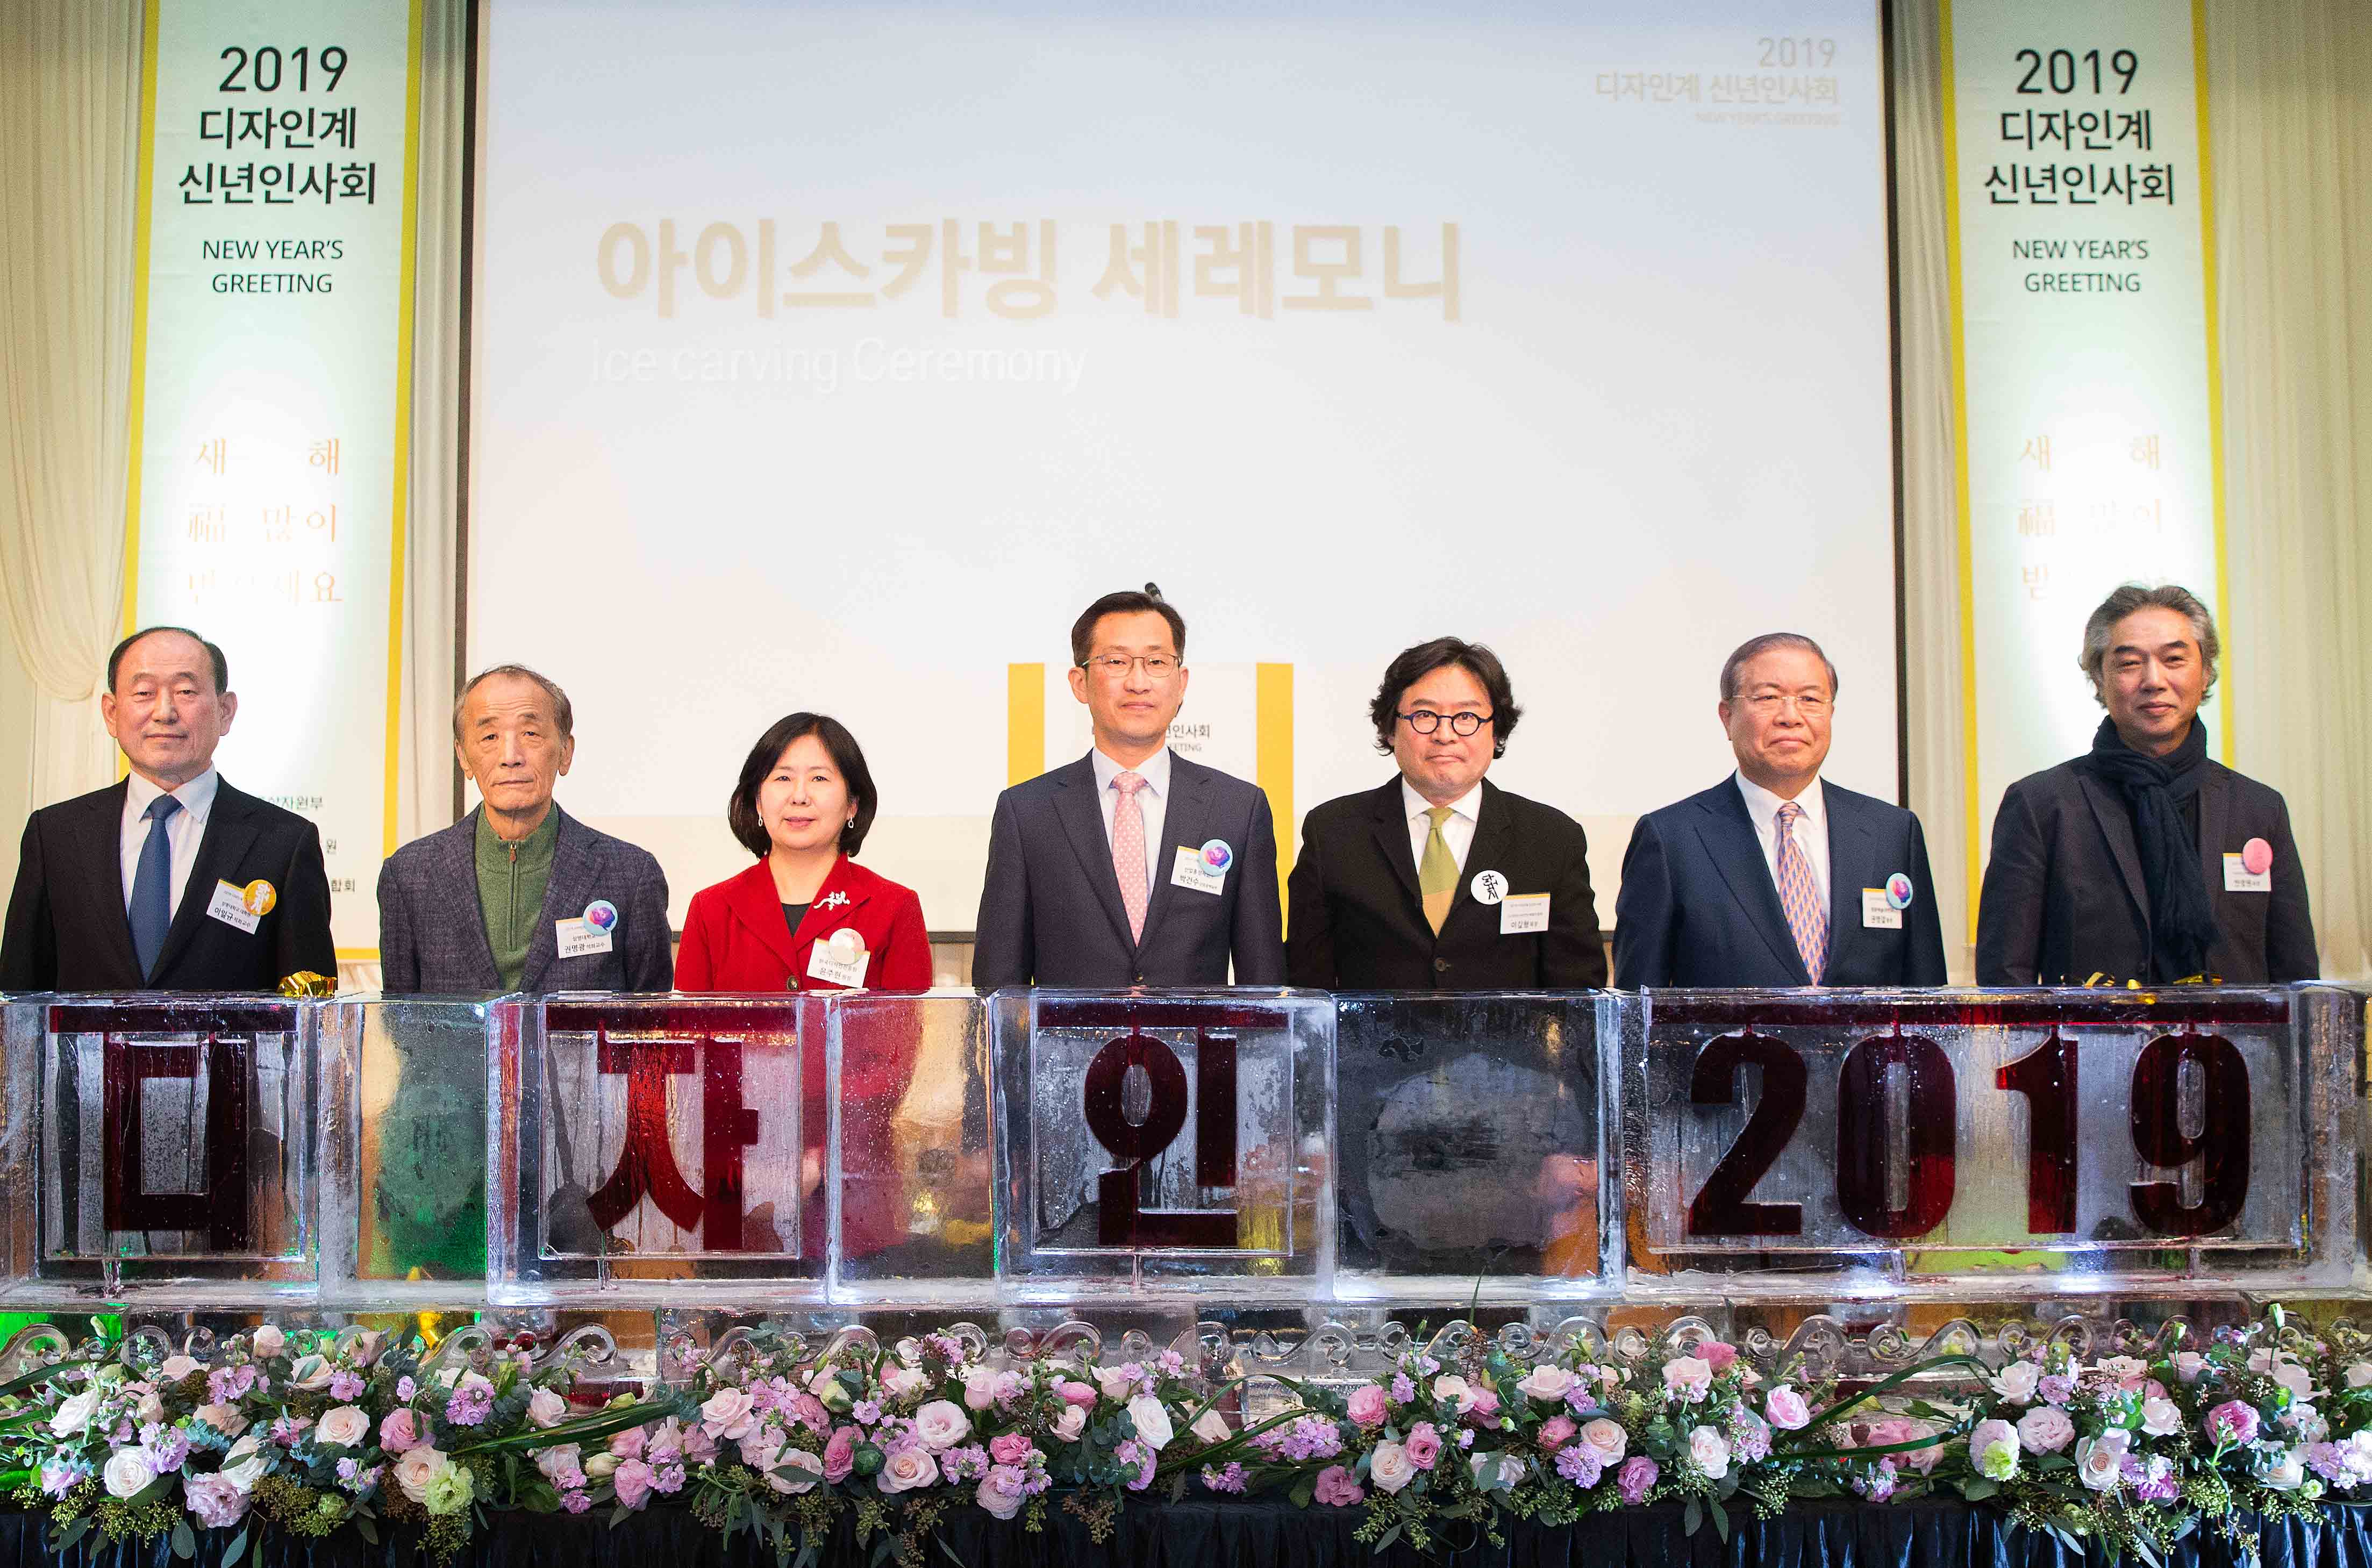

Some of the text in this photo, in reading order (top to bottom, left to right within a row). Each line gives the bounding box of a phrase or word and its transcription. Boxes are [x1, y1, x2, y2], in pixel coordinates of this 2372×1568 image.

[220, 47, 347, 91] 2019
[1758, 37, 1837, 68] 2019
[2015, 48, 2138, 94] 2019
[1595, 71, 1838, 105] 디자인계 신년인사회
[200, 107, 356, 149] 디자인계
[2001, 109, 2152, 151] 디자인계
[178, 162, 375, 204] 신년인사회
[1984, 163, 2174, 205] 신년인사회
[203, 240, 344, 259] NEW YEAR'S
[2013, 240, 2148, 259] NEW YEAR'S
[212, 274, 332, 293] GREETING
[597, 219, 1461, 323] 아이스카빙 세레모니
[2025, 273, 2140, 292] GREETING
[592, 336, 1088, 396] Ice carving Ceremony
[1688, 1031, 2251, 1239] 2019
